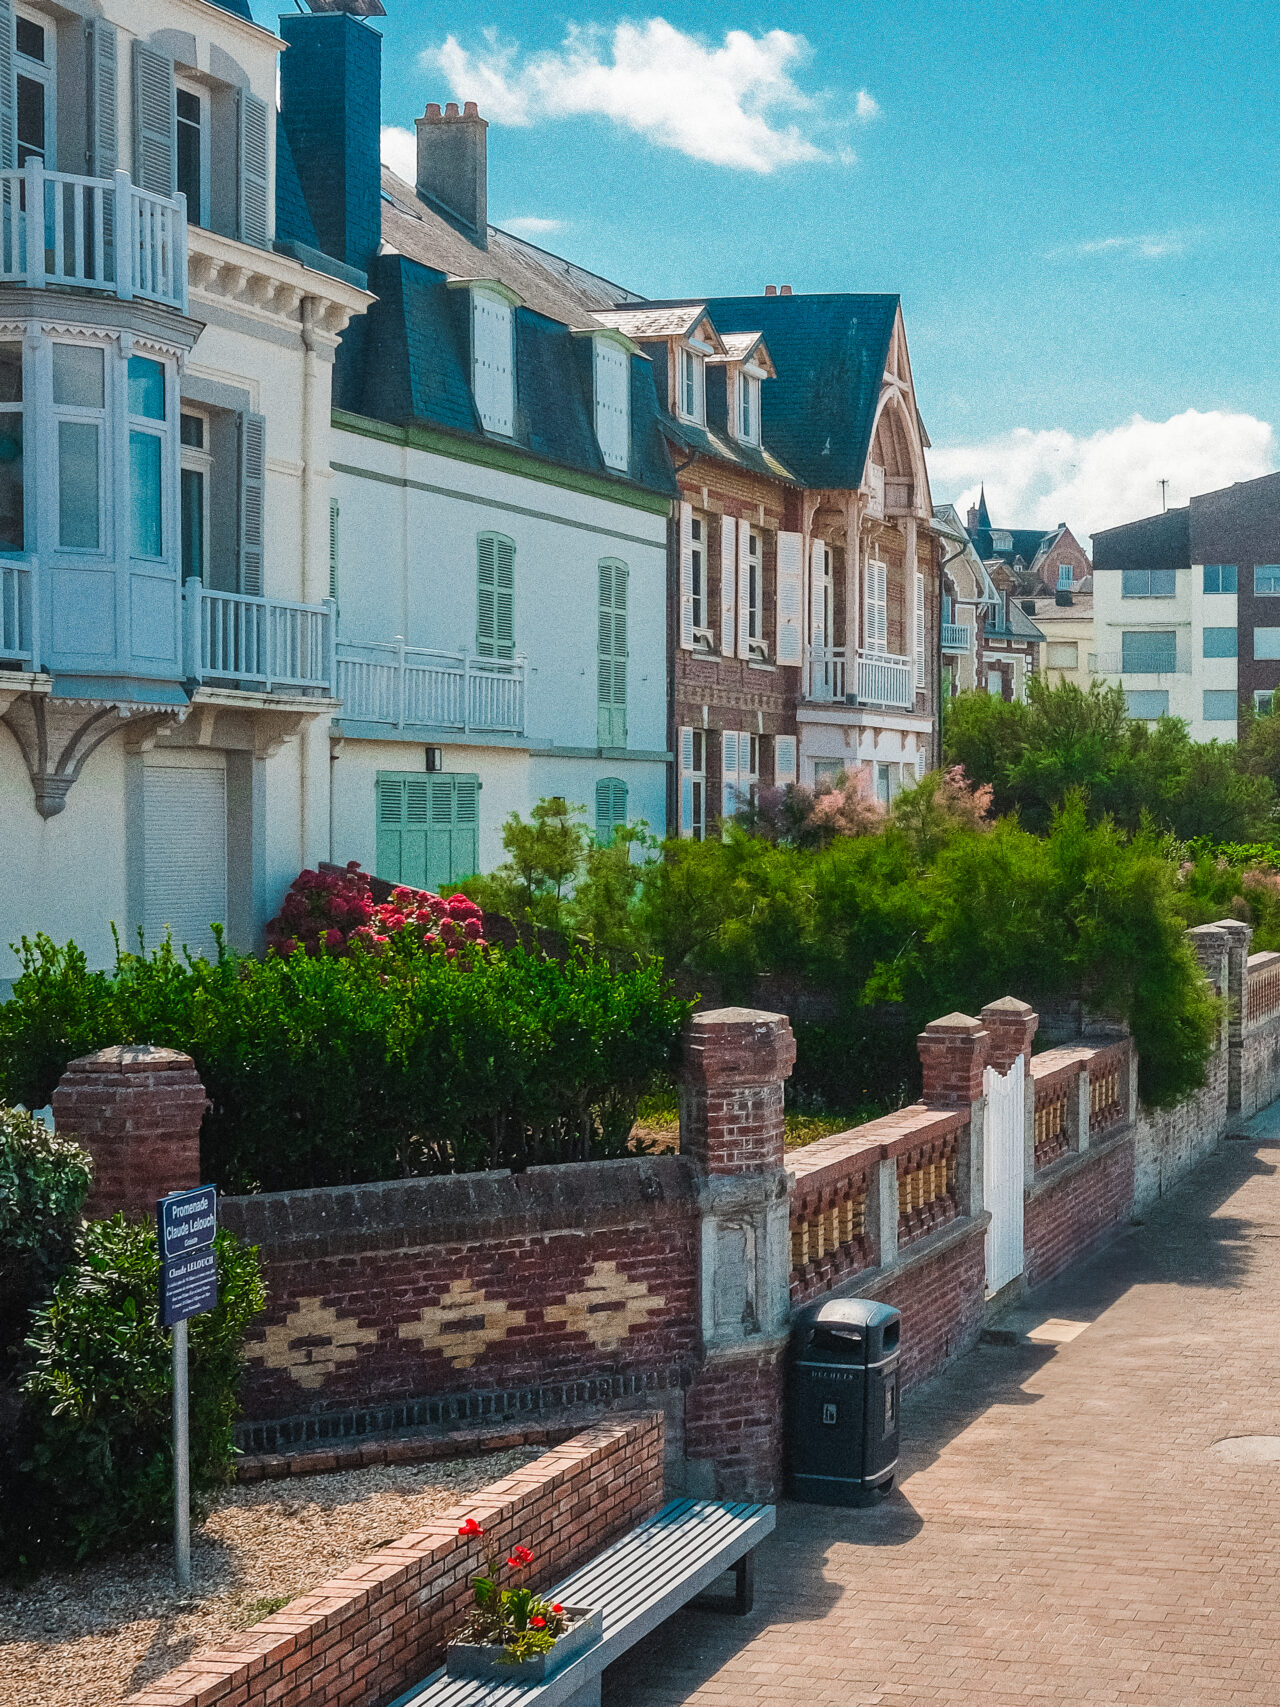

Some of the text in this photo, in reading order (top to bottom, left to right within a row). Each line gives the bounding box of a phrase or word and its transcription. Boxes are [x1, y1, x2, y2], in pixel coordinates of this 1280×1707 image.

[172, 1197, 209, 1219] Promenade
[166, 1213, 216, 1241] Claude Lelouch
[187, 1255, 214, 1272] LELOUCH
